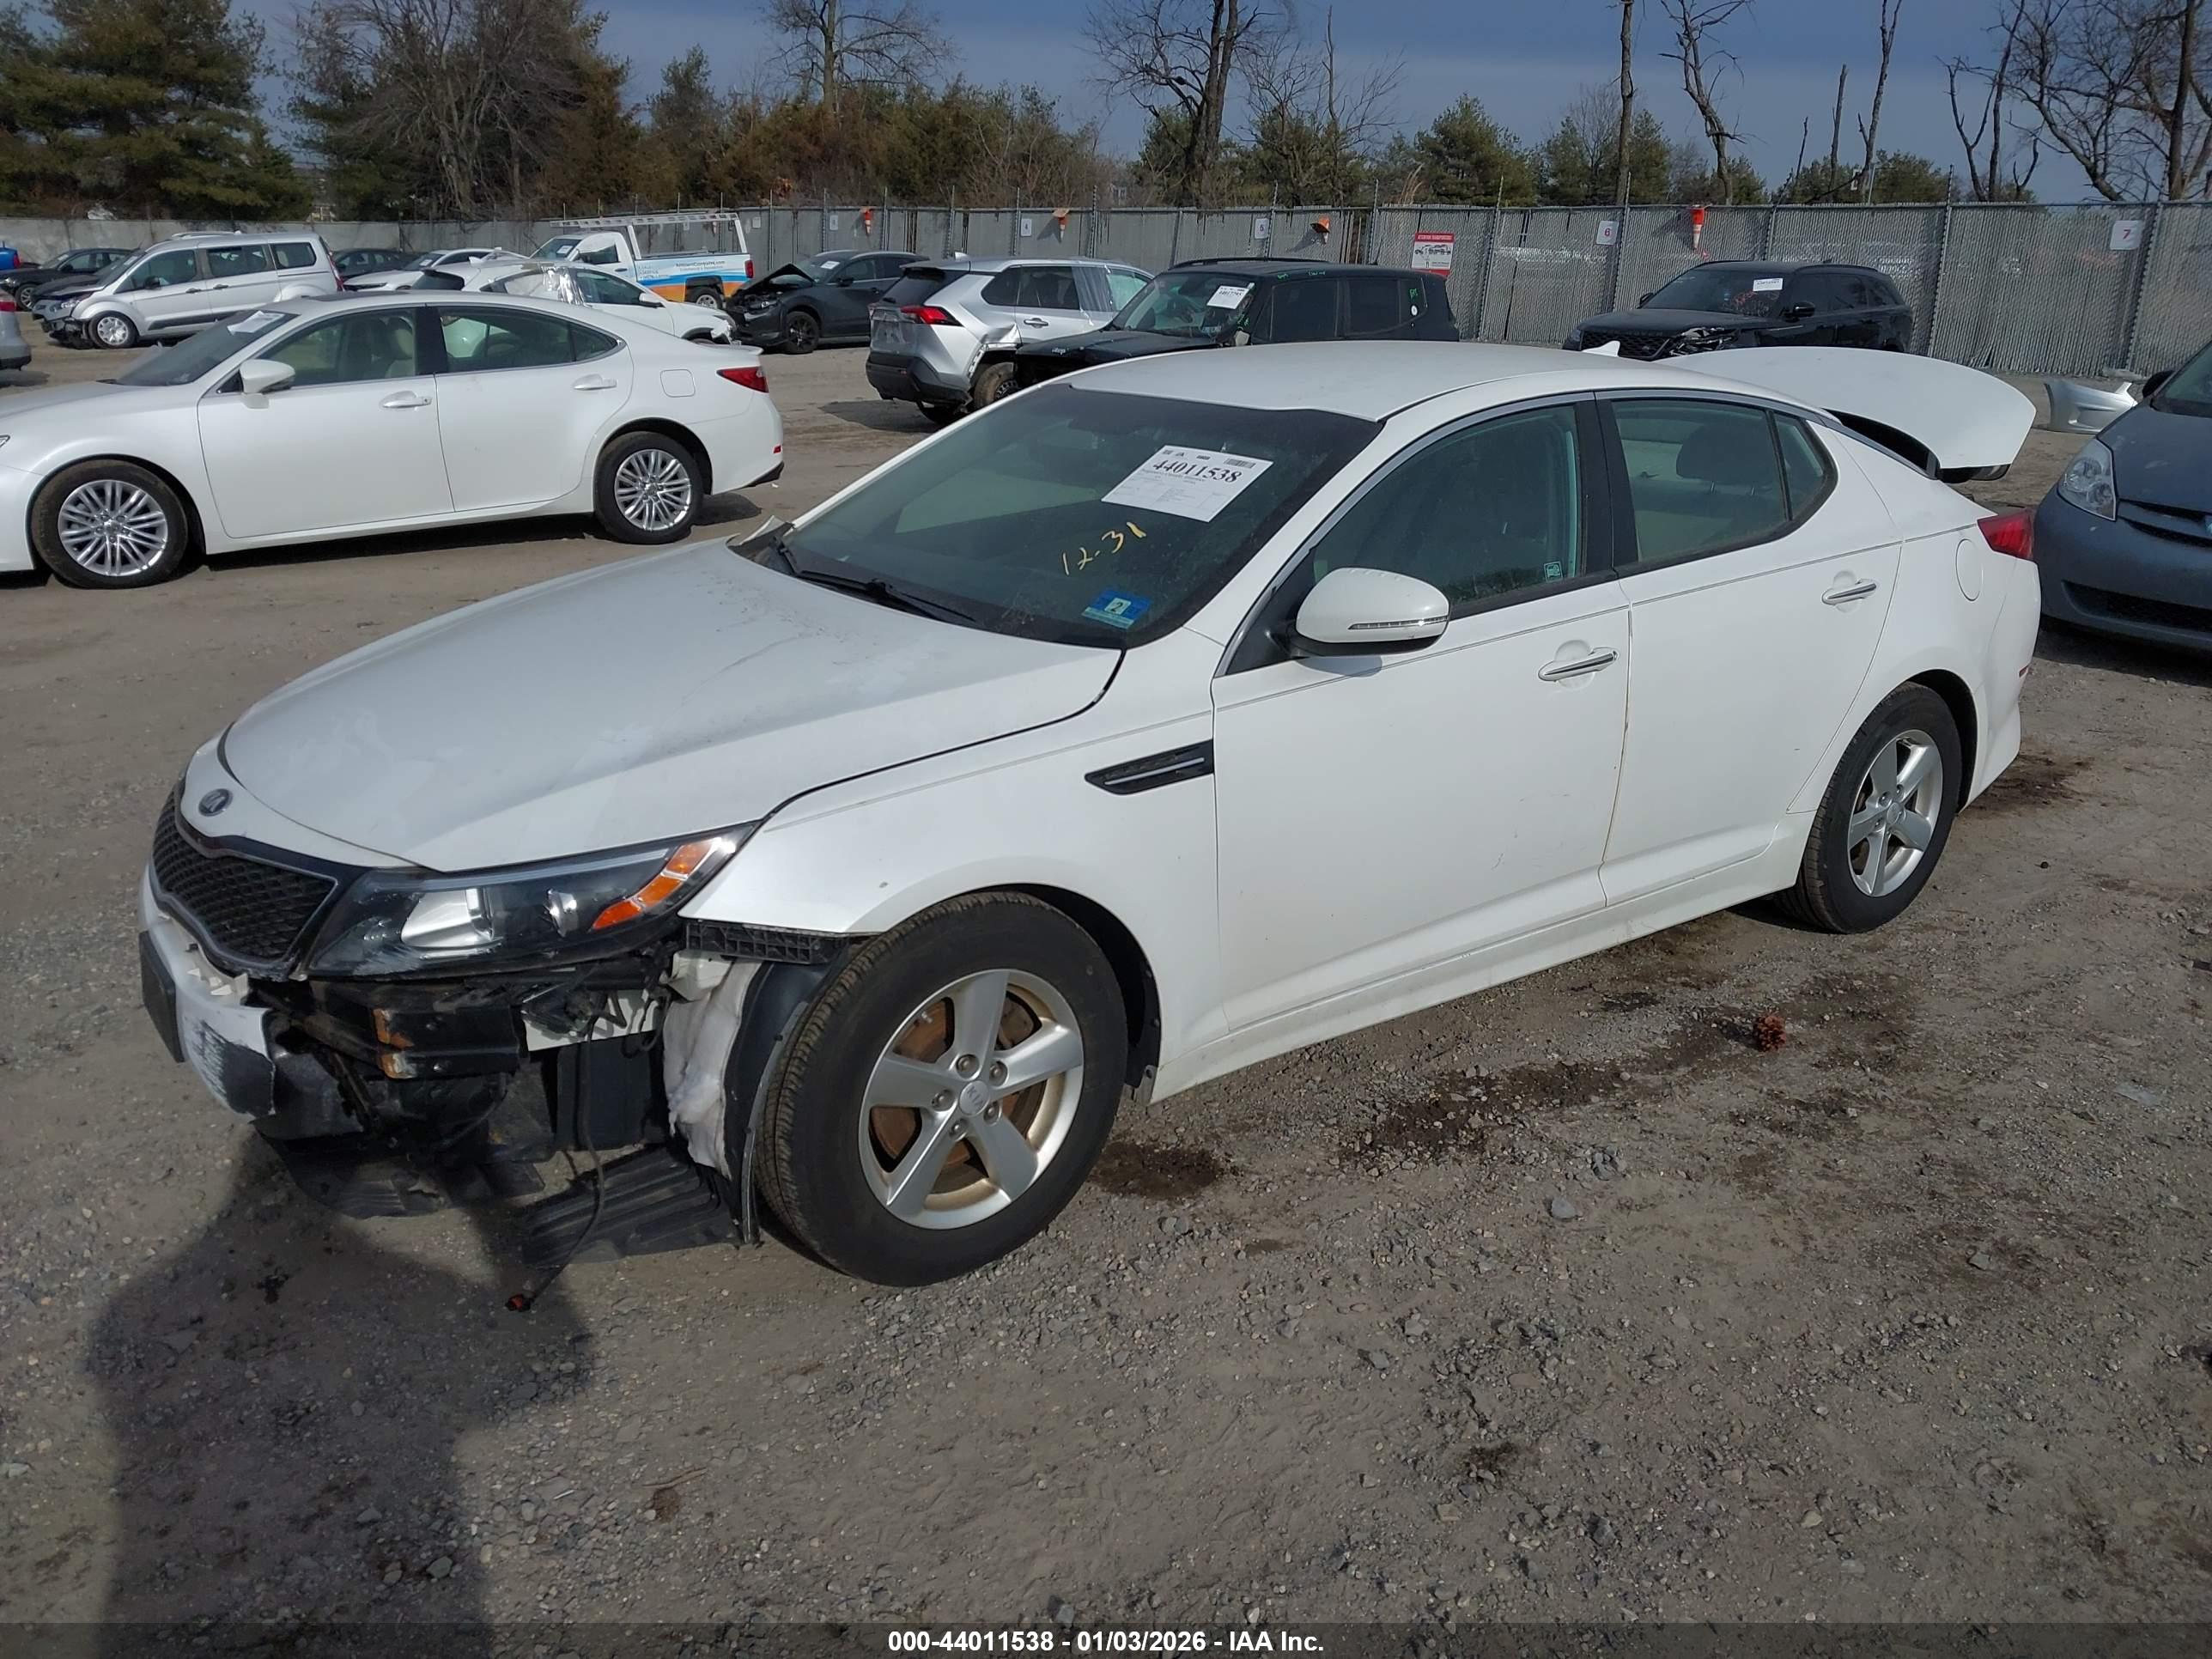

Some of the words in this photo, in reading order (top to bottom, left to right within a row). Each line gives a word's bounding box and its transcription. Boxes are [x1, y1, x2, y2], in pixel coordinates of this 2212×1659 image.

[1604, 228, 1611, 237] 6
[2123, 228, 2131, 240] 7
[1152, 459, 1243, 483] 44011538
[1110, 602, 1124, 612] 2
[967, 1085, 988, 1108] KIA
